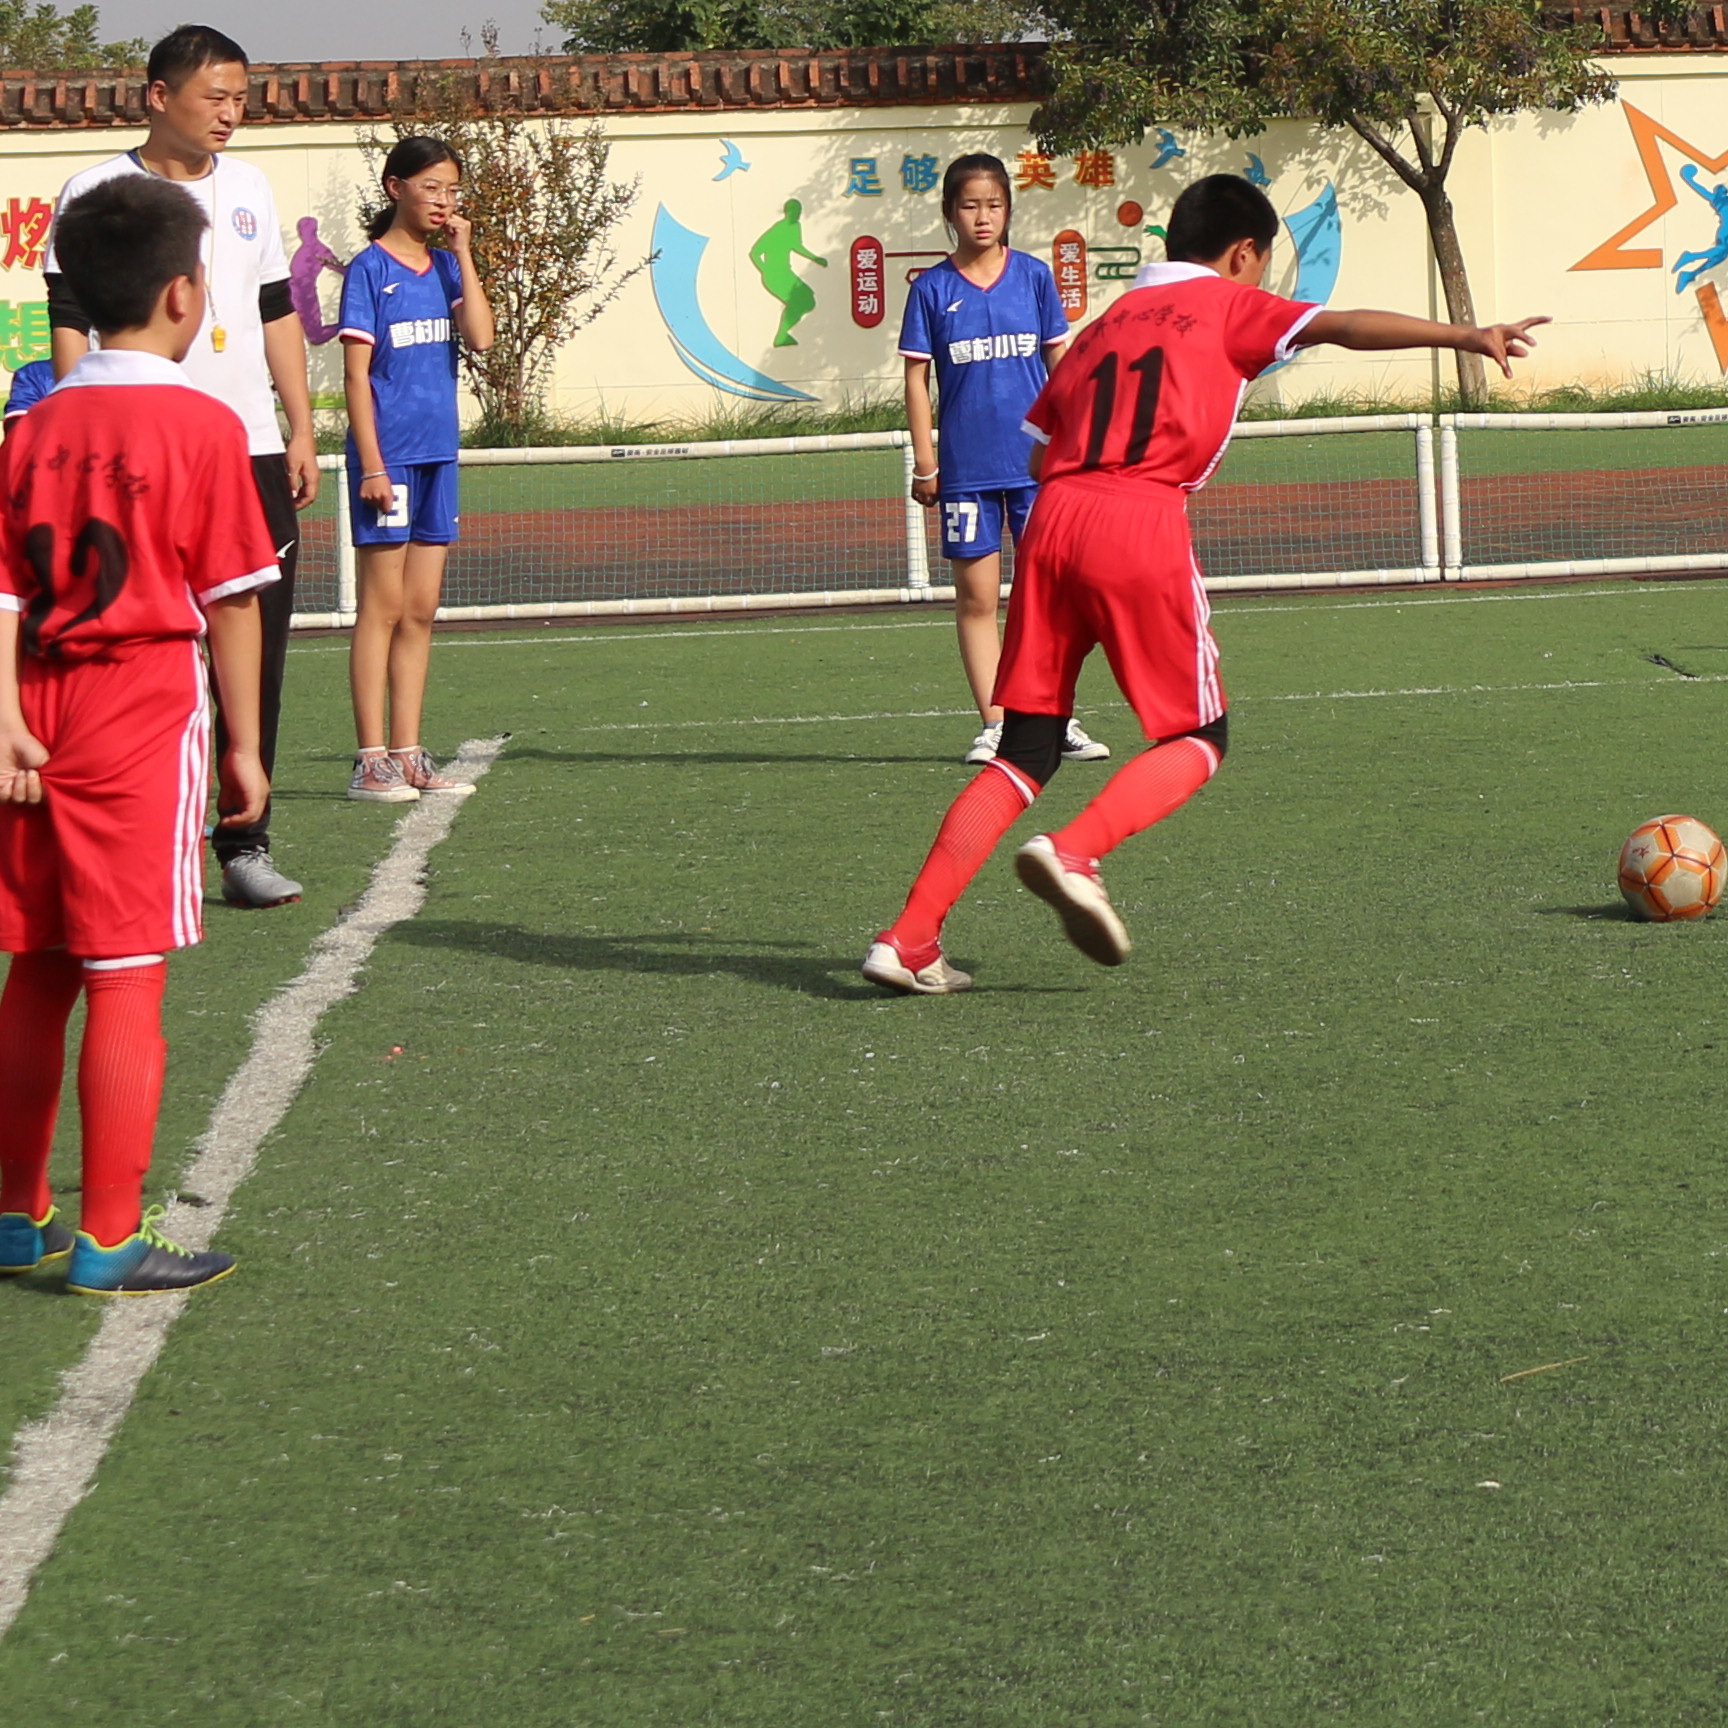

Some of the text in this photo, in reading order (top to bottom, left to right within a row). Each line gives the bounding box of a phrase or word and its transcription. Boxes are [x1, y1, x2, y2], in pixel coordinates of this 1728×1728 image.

[844, 149, 1116, 197] 足够英雄
[857, 248, 878, 315] 爱运动
[1059, 242, 1082, 309] 爱生活
[389, 318, 451, 349] 曹村小
[949, 333, 1038, 365] 曹村小学
[1080, 346, 1164, 470] 11
[945, 501, 979, 543] 27
